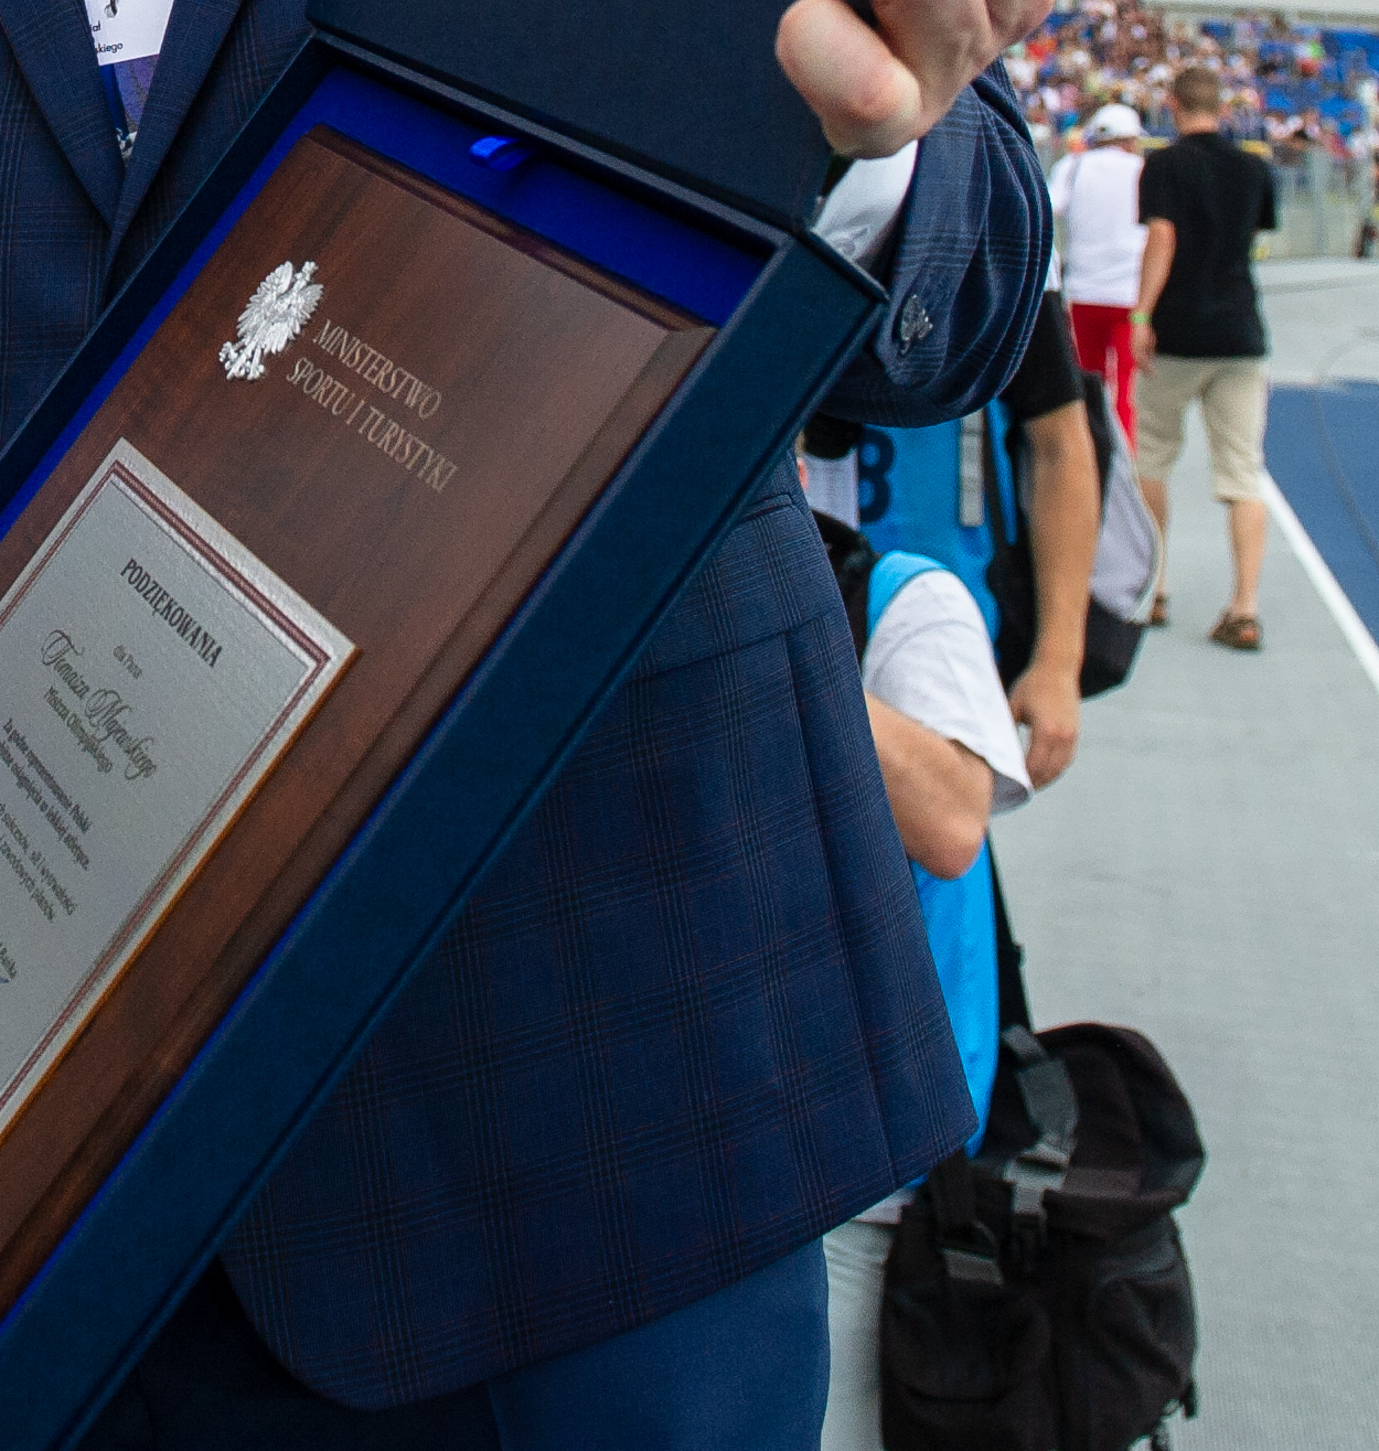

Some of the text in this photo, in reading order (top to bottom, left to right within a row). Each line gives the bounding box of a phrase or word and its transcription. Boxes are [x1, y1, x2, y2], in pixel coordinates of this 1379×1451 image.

[286, 356, 459, 495] SPORTU I TURYSTYKI
[313, 319, 443, 421] MINISTERSTWO
[119, 557, 222, 668] PODZIĘKOWANIA
